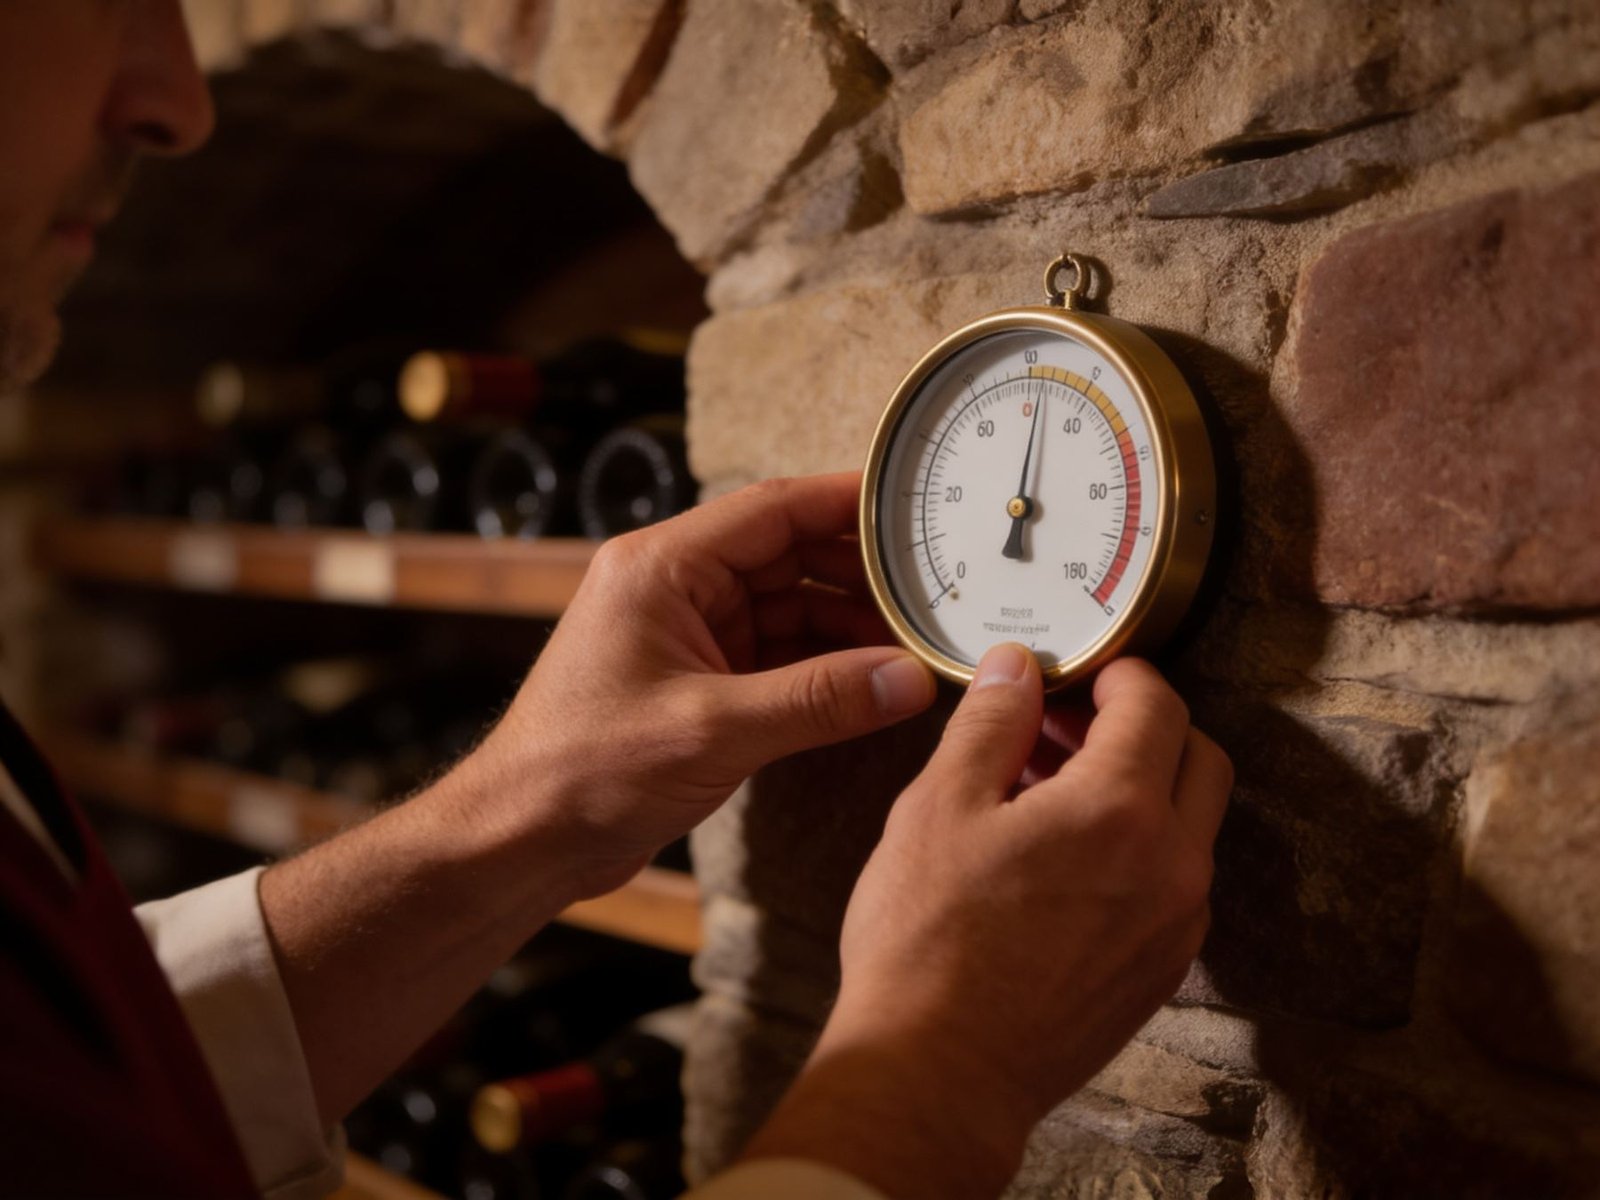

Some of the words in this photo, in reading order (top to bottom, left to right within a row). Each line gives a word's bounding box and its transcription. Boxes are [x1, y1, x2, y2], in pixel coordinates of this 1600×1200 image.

[977, 420, 995, 437] 60
[1063, 418, 1082, 434] 40
[945, 486, 963, 503] 20
[956, 561, 966, 579] 0
